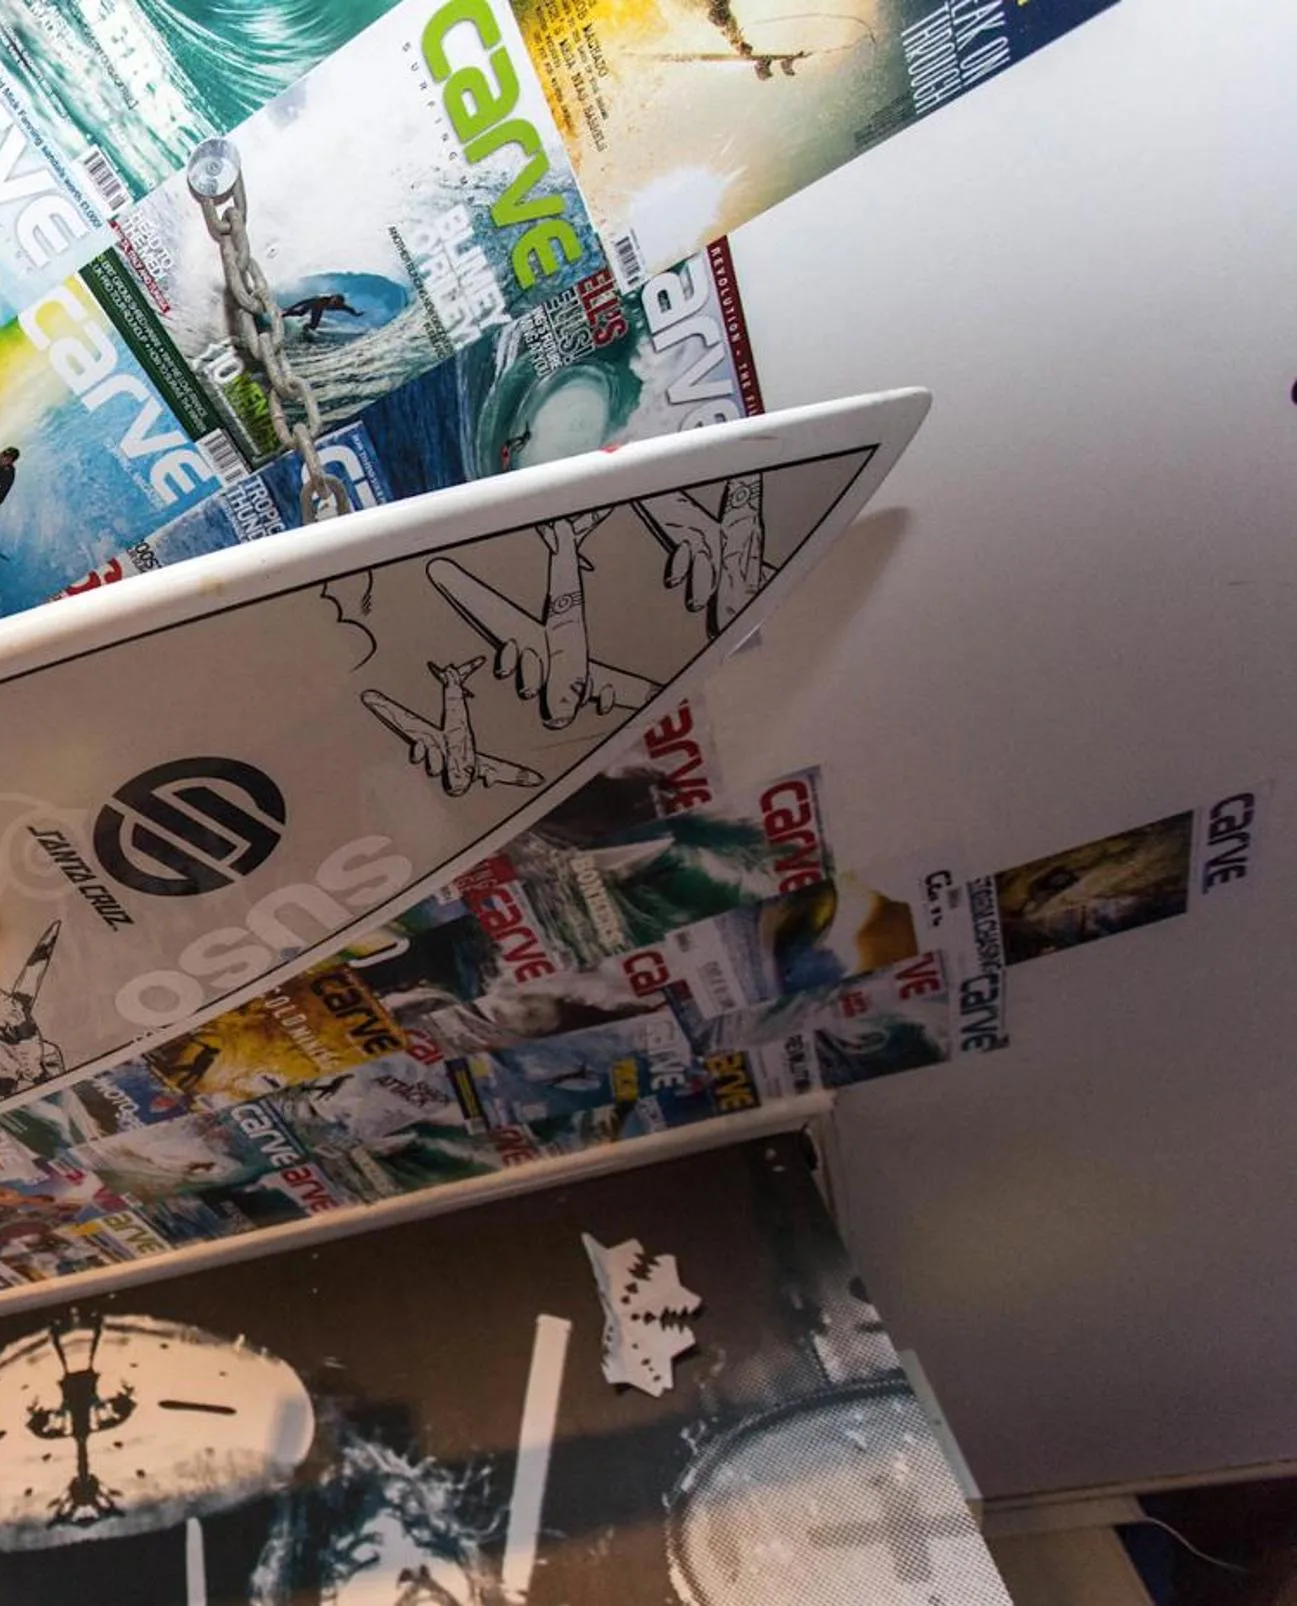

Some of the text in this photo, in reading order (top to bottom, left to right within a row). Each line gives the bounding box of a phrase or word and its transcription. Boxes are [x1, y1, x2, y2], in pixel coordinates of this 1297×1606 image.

[899, 1, 962, 114] THROUGH
[0, 86, 22, 112] Mick
[15, 108, 45, 146] Fanning
[709, 246, 741, 342] REVOLUTION
[736, 362, 752, 387] THE
[243, 475, 286, 536] TROPIC
[27, 824, 135, 934] SANTA CRUZ
